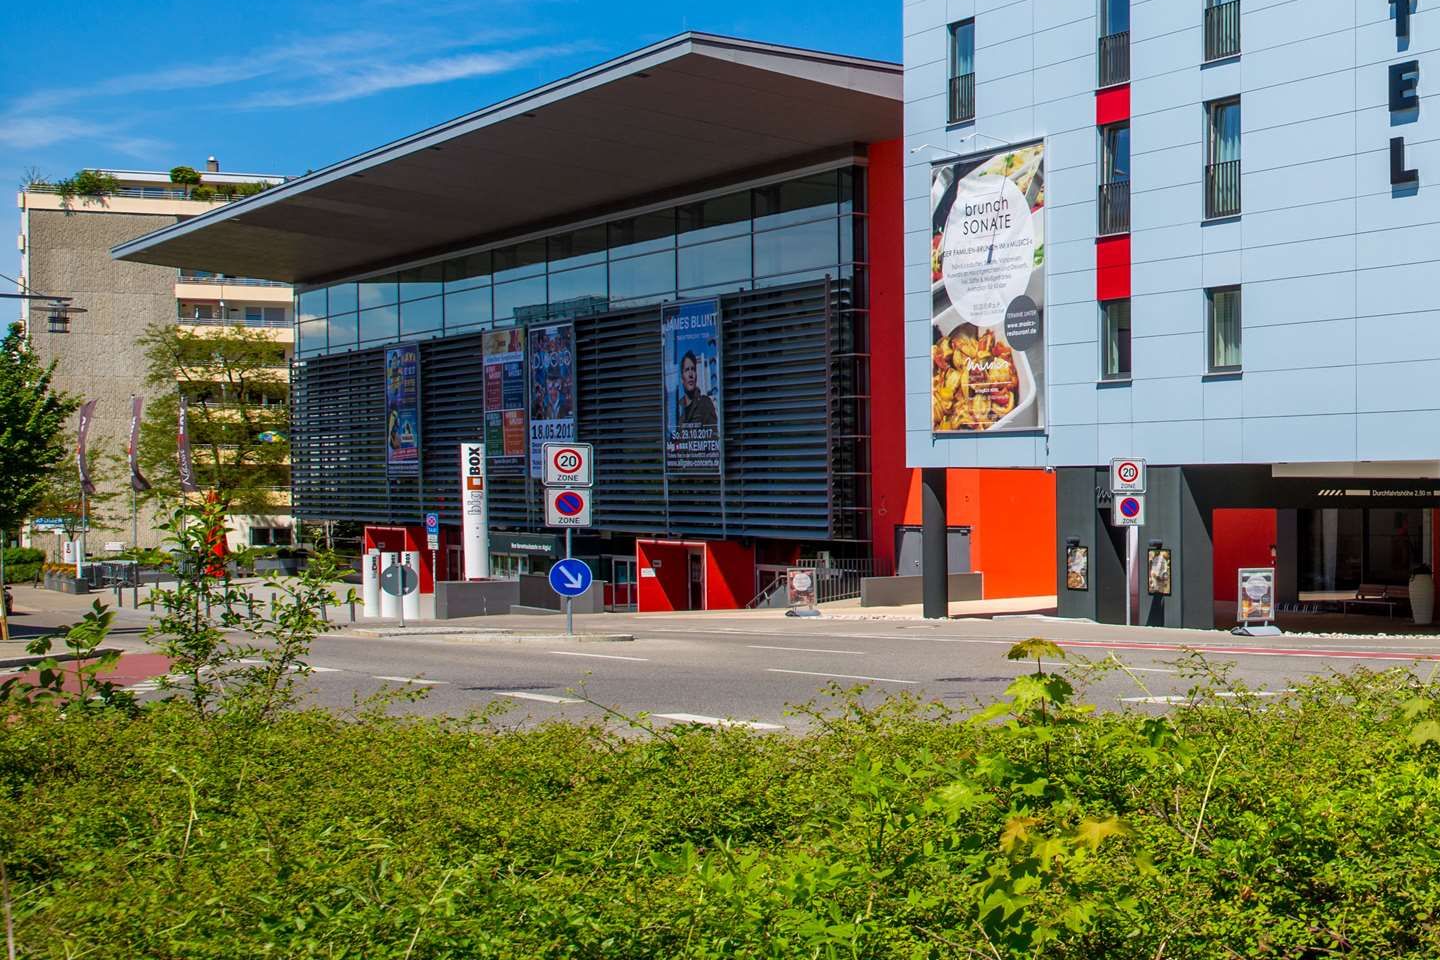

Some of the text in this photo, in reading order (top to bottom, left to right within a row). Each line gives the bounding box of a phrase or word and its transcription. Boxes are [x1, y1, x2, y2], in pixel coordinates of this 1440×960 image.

[965, 197, 1008, 216] brunch
[963, 214, 1011, 235] SONATE
[690, 312, 718, 329] BLUNT
[469, 447, 480, 475] BOX
[560, 455, 577, 467] 20
[557, 474, 579, 482] ZONE
[1123, 467, 1135, 477] 20
